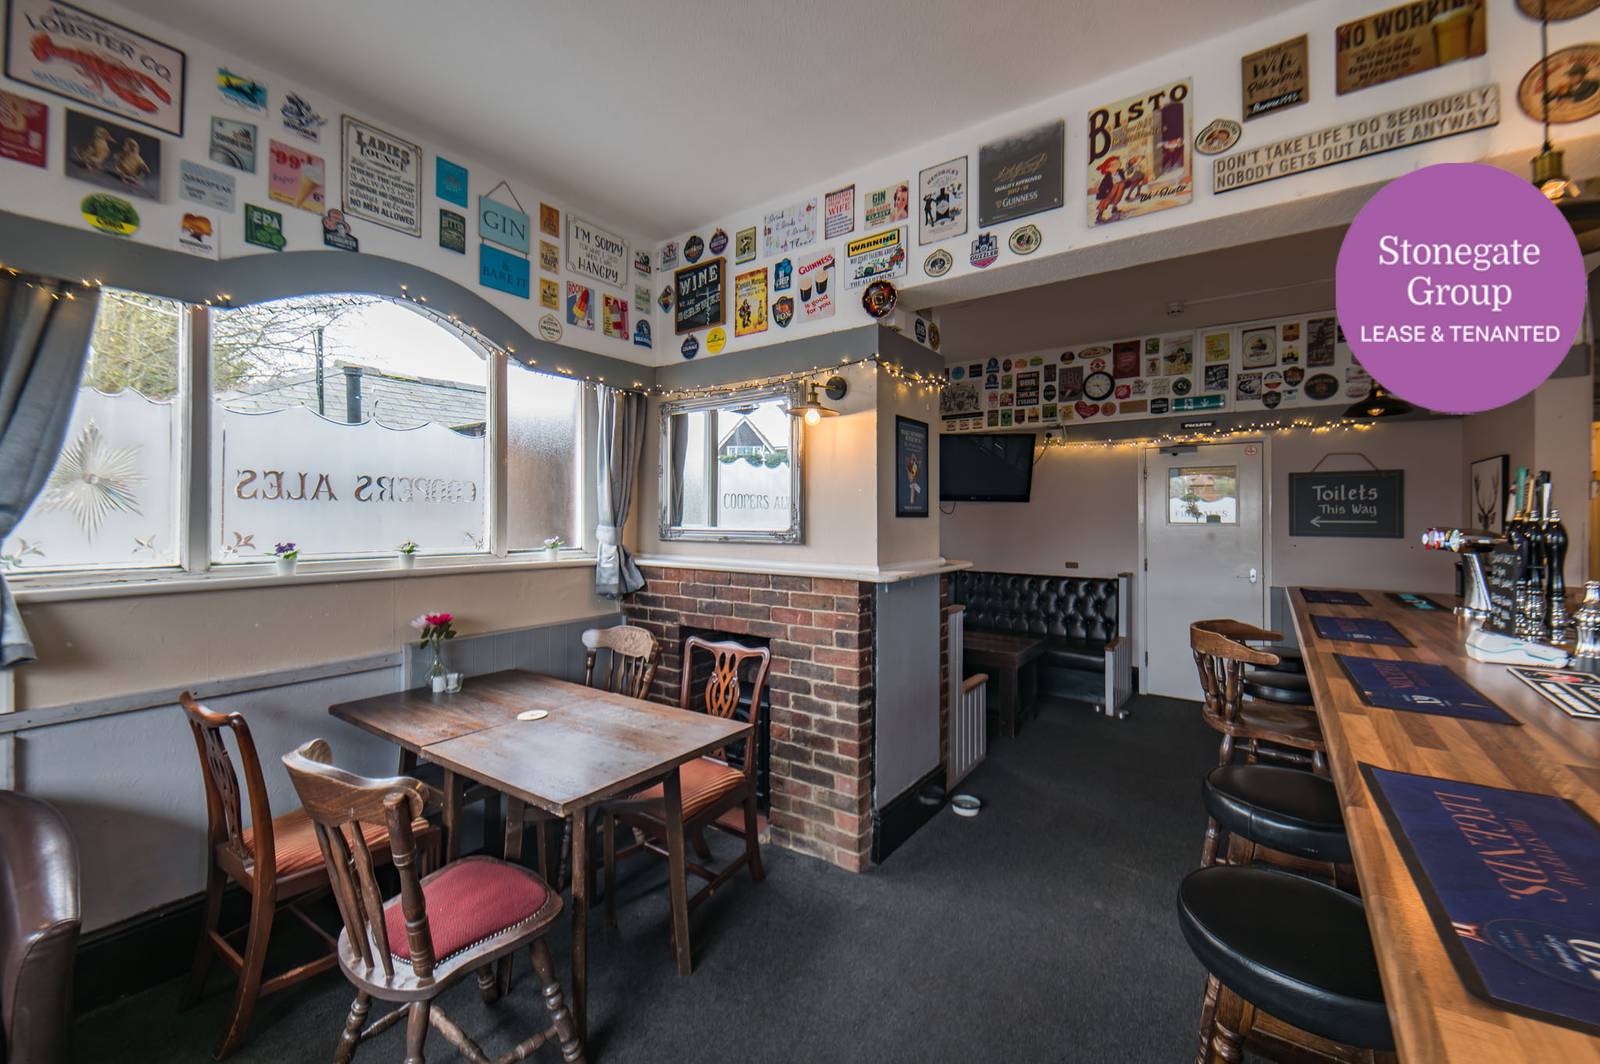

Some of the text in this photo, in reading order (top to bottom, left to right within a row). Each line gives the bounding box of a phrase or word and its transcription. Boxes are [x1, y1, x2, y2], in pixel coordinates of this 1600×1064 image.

[24, 12, 135, 60] LOBSTER
[1339, 0, 1482, 52] NO WORKI
[1348, 47, 1421, 75] DRINKING
[1216, 150, 1260, 173] DON'T
[1264, 139, 1302, 164] TAKE
[1308, 129, 1341, 151] LIFE
[1349, 118, 1380, 139] TOO
[1386, 87, 1490, 130] SERIOUSLY
[1216, 109, 1490, 189] NOBODY GETS OUT ALIVE ANYWAY
[360, 176, 396, 194] ALWAYS
[872, 190, 886, 204] GIN
[1003, 191, 1038, 207] GUINNESS
[253, 210, 280, 230] EPA
[350, 197, 415, 226] NO MEN ALLOWED
[482, 210, 525, 241] GIN
[575, 226, 624, 256] I'M SORRY
[850, 233, 896, 253] WARNING
[578, 257, 619, 283] HANGRY
[799, 254, 834, 275] GUINNESS
[680, 264, 718, 295] WINE
[806, 301, 831, 316] for you
[811, 294, 828, 307] good
[723, 493, 770, 510] COOPERS
[1311, 484, 1378, 501] Toilets
[1318, 504, 1377, 517] This Way
